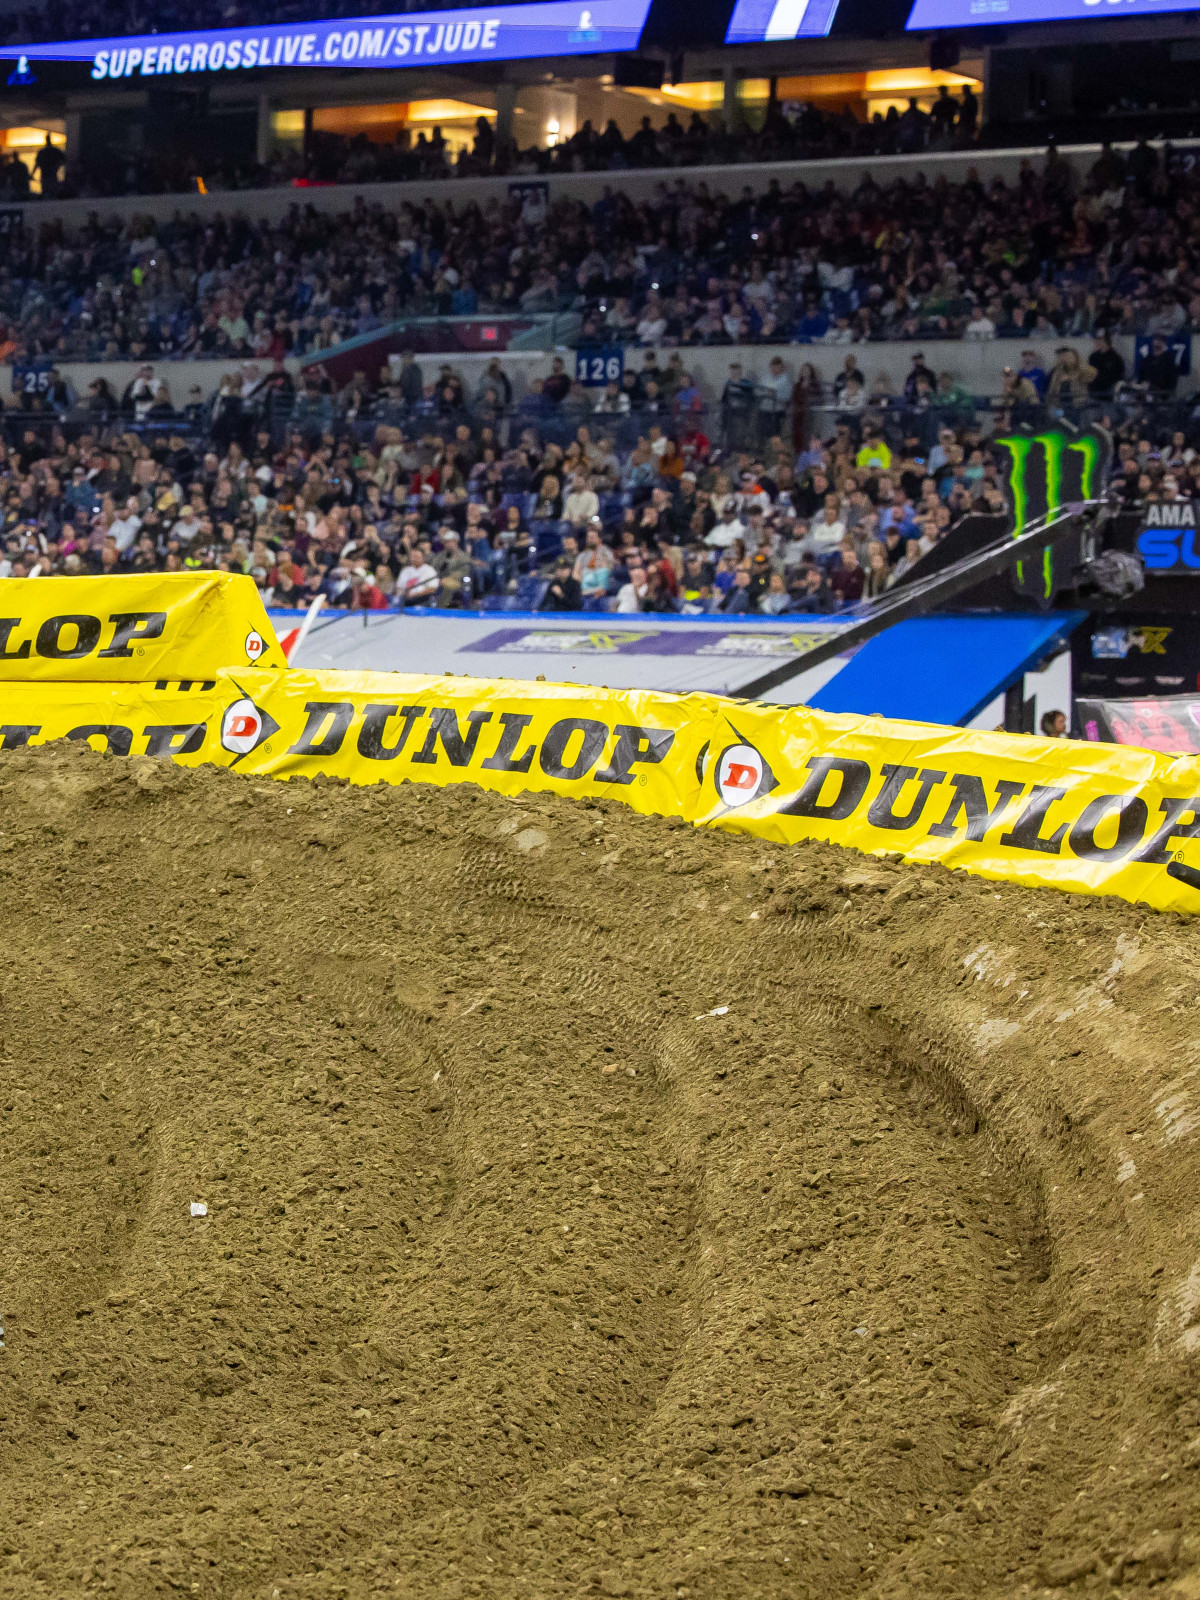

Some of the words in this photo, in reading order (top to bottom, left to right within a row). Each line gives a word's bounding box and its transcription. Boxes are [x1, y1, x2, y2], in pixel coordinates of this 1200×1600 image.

[578, 357, 620, 380] 126
[17, 371, 49, 393] 25
[1147, 504, 1196, 526] AMA
[287, 702, 676, 786] DUNLOP
